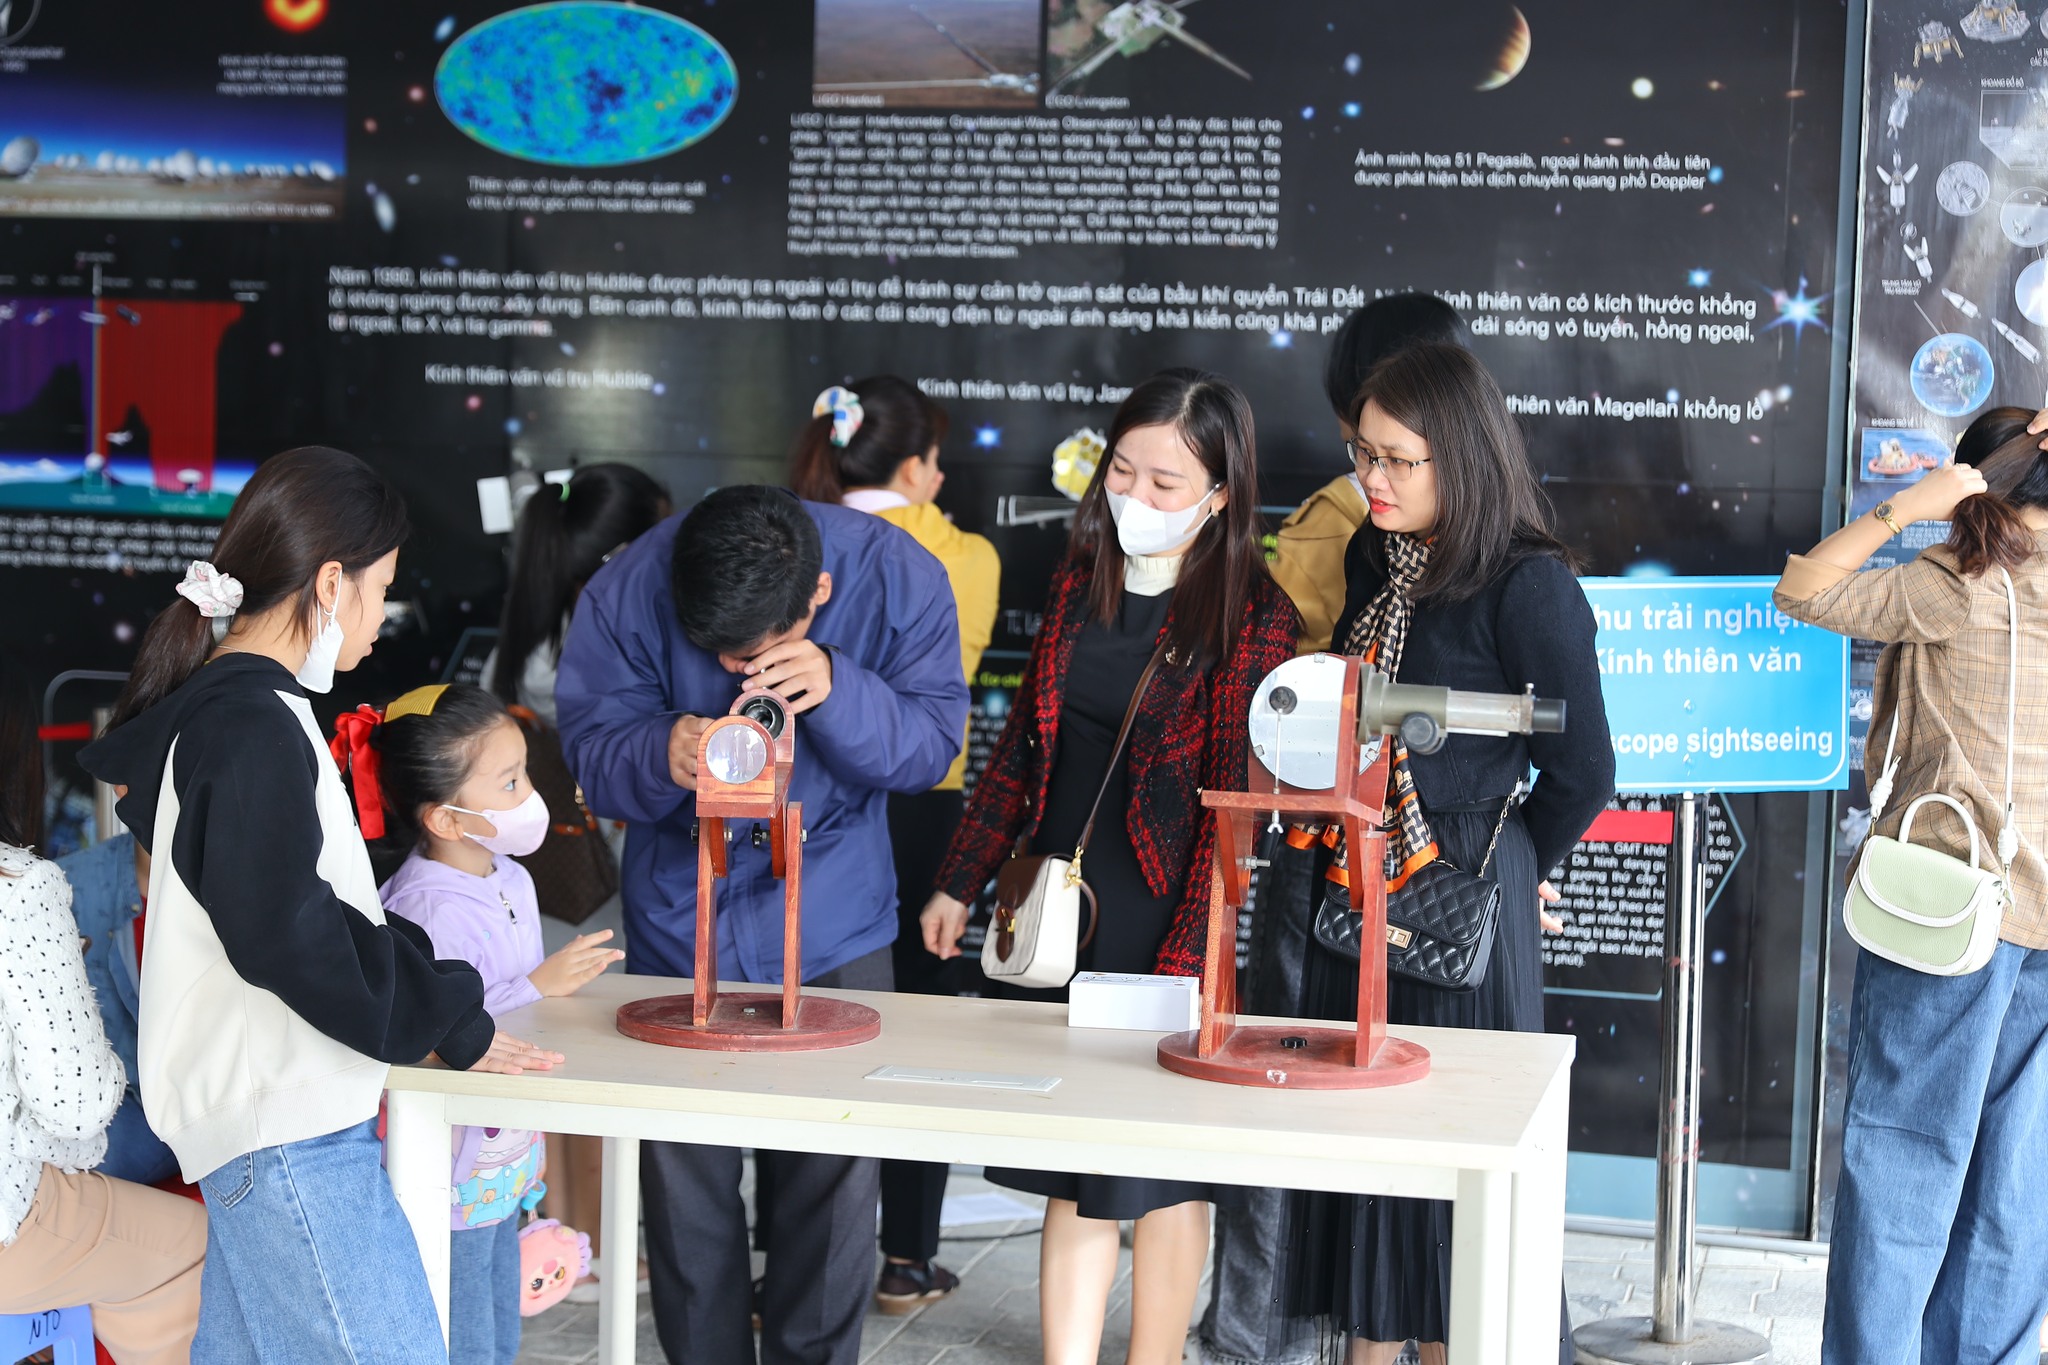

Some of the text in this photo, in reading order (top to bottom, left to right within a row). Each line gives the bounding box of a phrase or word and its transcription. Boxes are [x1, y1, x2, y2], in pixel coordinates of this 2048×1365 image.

[1355, 149, 1384, 167] Ảnh
[1386, 151, 1421, 168] minh
[1424, 151, 1451, 170] họa
[1454, 151, 1472, 168] 51
[1540, 152, 1580, 172] ngoại
[1583, 153, 1619, 170] hành
[1653, 151, 1680, 170] đầu
[1684, 153, 1711, 171] tiên
[1354, 169, 1705, 192] được phát hiện bởi dịch chuyển quang phổ Doppler
[586, 271, 647, 292] Hubble
[753, 279, 774, 297] ra
[905, 279, 950, 300] tránh
[1127, 283, 1160, 304] của
[1163, 280, 1198, 305] bầu
[1201, 284, 1231, 306] khí
[1233, 282, 1289, 310] quyển
[1293, 286, 1328, 308] Trái
[1434, 289, 1472, 310] ính
[1477, 290, 1522, 311] thiên
[1527, 291, 1561, 312] văn
[1566, 292, 1589, 312] có
[1594, 292, 1633, 313] kích
[1637, 293, 1694, 314] thước
[1699, 292, 1757, 319] khổng
[702, 298, 741, 319] kính
[742, 298, 786, 320] thiên
[840, 301, 875, 322] các
[905, 302, 950, 328] sóng
[1070, 306, 1106, 327] ánh
[1108, 307, 1153, 332] sáng
[1193, 306, 1231, 330] kiến
[1235, 310, 1279, 335] cũng
[1283, 311, 1317, 331] khá
[1471, 315, 1755, 344] dải sóng vô tuyến, hồng ngoại,
[917, 377, 1133, 406] Kính thiên văn vũ trụ Jam
[1506, 394, 1764, 423] thiên văn Magellan khổng lồ
[1594, 603, 1632, 631] hu
[1642, 601, 1693, 630] trải
[1663, 647, 1738, 674] thiên
[1748, 646, 1802, 672] văn
[1611, 732, 1679, 759] scope
[1686, 726, 1833, 757] sightseeing
[1614, 842, 1641, 855] GMT
[1643, 843, 1667, 857] khô
[1571, 854, 1589, 867] Do
[1593, 854, 1618, 868] hình
[1623, 856, 1651, 872] dạng
[1569, 869, 1607, 885] gương
[1612, 869, 1632, 883] thứ
[1627, 884, 1651, 899] xuất
[1573, 897, 1595, 910] nhỏ
[1596, 897, 1617, 913] xếp
[1619, 900, 1644, 912] theo
[1597, 911, 1628, 926] nhiễu
[1605, 927, 1627, 940] bão
[1552, 938, 1573, 952] các
[1574, 940, 1598, 954] ngôi
[1599, 943, 1620, 954] sao
[1622, 940, 1643, 956] nếu
